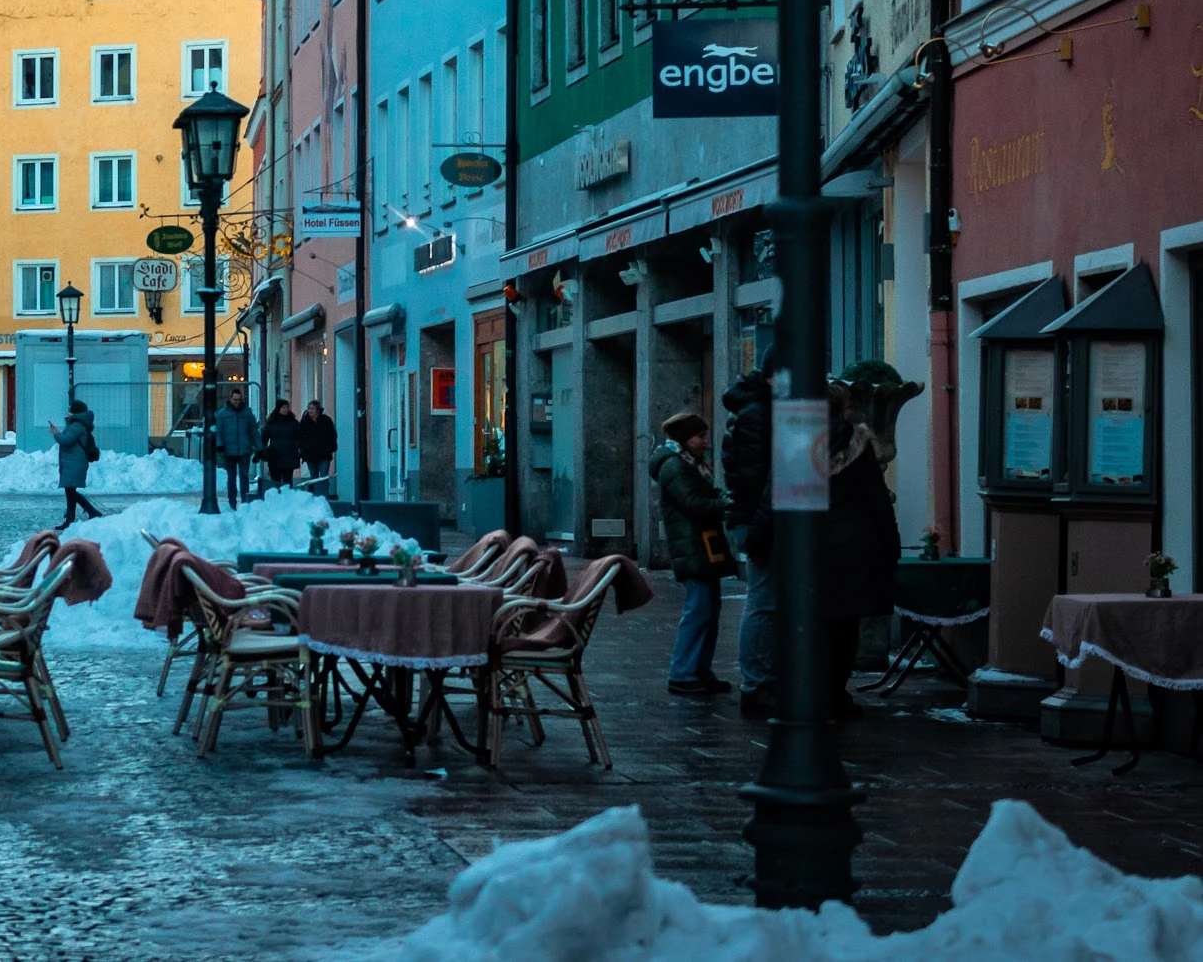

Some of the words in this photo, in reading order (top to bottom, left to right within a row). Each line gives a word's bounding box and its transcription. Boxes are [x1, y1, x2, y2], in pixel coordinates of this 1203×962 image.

[659, 56, 780, 93] engbe
[304, 219, 327, 228] Hotel
[329, 218, 360, 228] Füssen
[136, 261, 173, 275] Stadt
